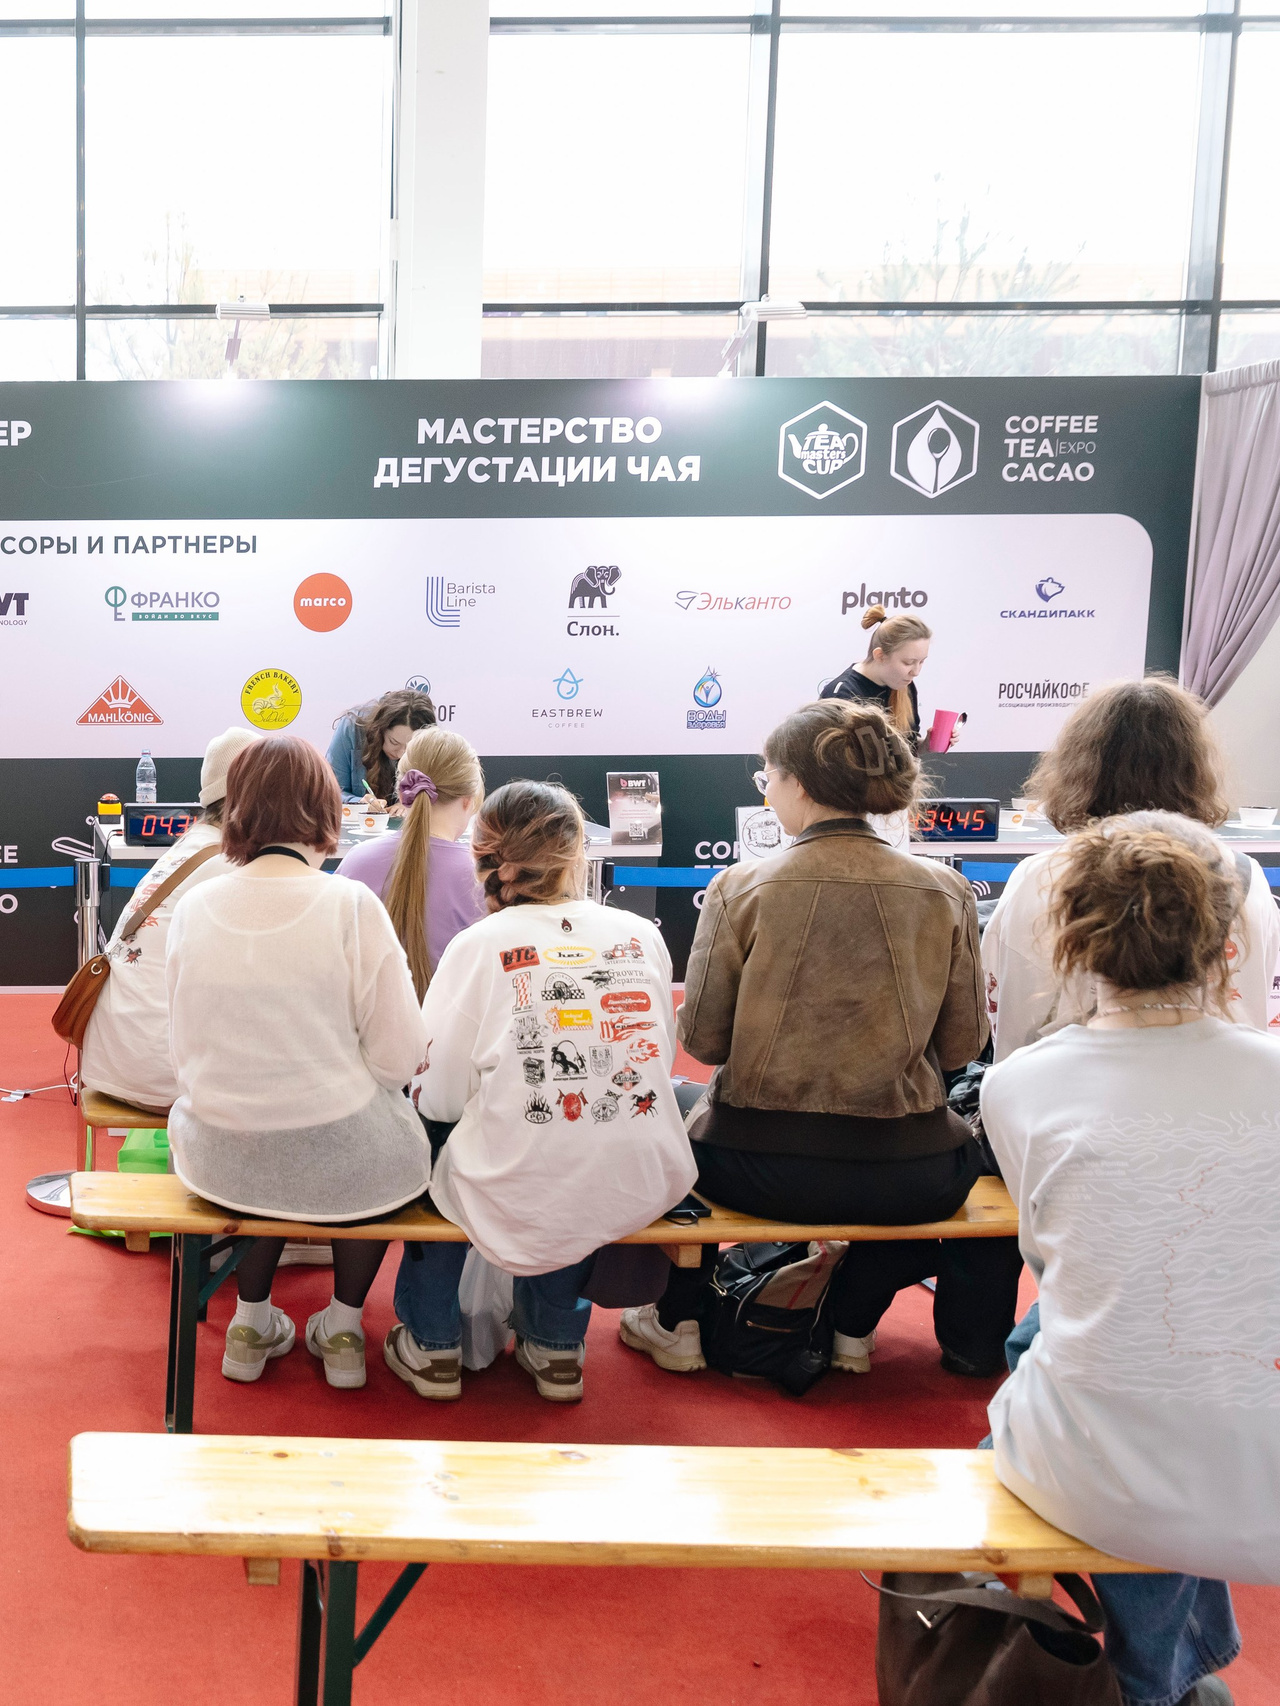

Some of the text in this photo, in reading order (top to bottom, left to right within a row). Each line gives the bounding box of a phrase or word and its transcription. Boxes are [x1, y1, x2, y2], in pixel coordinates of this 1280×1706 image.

[417, 417, 663, 445] МАСТЕРСТВО
[1005, 415, 1099, 434] COFFEE
[803, 434, 845, 451] TEA
[1004, 437, 1097, 458] TEA EXPO
[800, 449, 846, 460] masters
[374, 454, 701, 488] ДЕГУСТАЦИИ ЧАЯ
[802, 460, 843, 475] CUP
[1001, 462, 1095, 483] CACAO
[88, 536, 104, 555] И
[113, 535, 257, 555] ПАРТНЕРЫ
[447, 582, 496, 595] Barista
[130, 591, 220, 608] ФРАНКО
[300, 597, 347, 608] marco
[447, 595, 477, 608] Line
[697, 591, 792, 611] Эльканто
[841, 582, 928, 615] planto
[1000, 609, 1096, 619] СКАНДИПАКК
[245, 671, 299, 695] FRENCH BAKERY
[998, 679, 1090, 700] РОСЧАЙКОФЕ
[88, 710, 155, 723] MAHLKÖNIG
[433, 704, 456, 722] OF
[531, 708, 603, 718] EASTBREW
[687, 710, 727, 722] ВОДЫ
